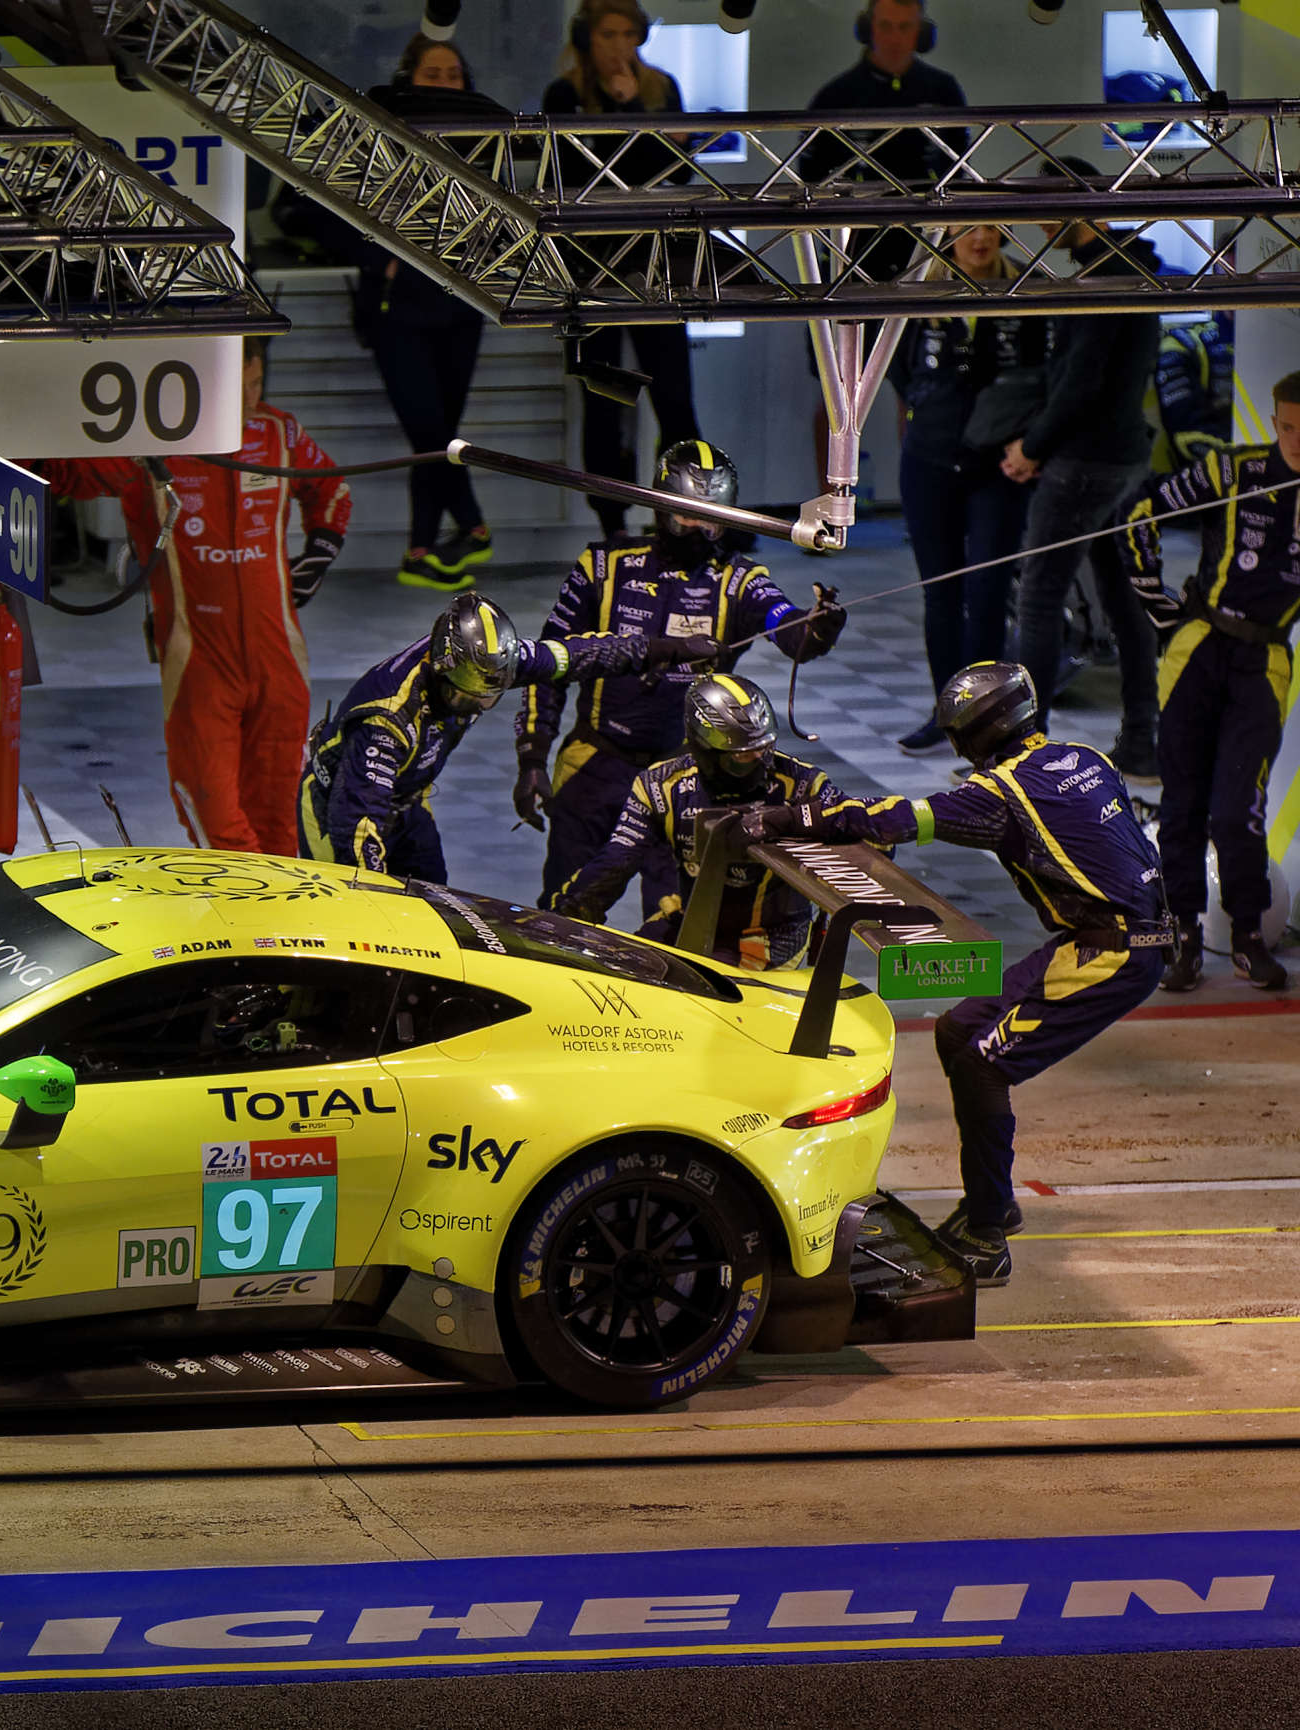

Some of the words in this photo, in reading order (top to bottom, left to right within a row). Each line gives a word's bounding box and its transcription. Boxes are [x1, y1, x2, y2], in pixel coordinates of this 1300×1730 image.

[81, 360, 201, 443] 90
[10, 487, 38, 582] 90
[193, 545, 268, 563] TOTAL
[1056, 774, 1081, 794] ASTON
[1100, 798, 1123, 823] AMR
[792, 854, 894, 897] MARTIN
[181, 939, 232, 955] ADAM
[281, 938, 326, 949] LYNN
[375, 945, 442, 959] MARTIN
[893, 957, 990, 977] HACKETT
[918, 976, 966, 986] LONDON
[548, 1024, 621, 1038] WALDORF
[625, 1028, 684, 1041] ASTORIA
[563, 1041, 609, 1052] HOTELS
[612, 1042, 620, 1051] &
[623, 1042, 674, 1053] RESORTS
[208, 1086, 396, 1123] TOTAL
[308, 1121, 327, 1130] PUSH
[727, 1113, 765, 1133] DUPONT
[206, 1145, 247, 1168] 24h
[254, 1152, 331, 1168] TOTAL
[427, 1125, 531, 1183] sky
[528, 1164, 606, 1255] MICHELIN
[217, 1186, 323, 1270] 97
[123, 1237, 190, 1278] PRO
[232, 1275, 318, 1298] WEC
[283, 1352, 310, 1370] PAGID
[661, 1315, 748, 1394] MICHELIN
